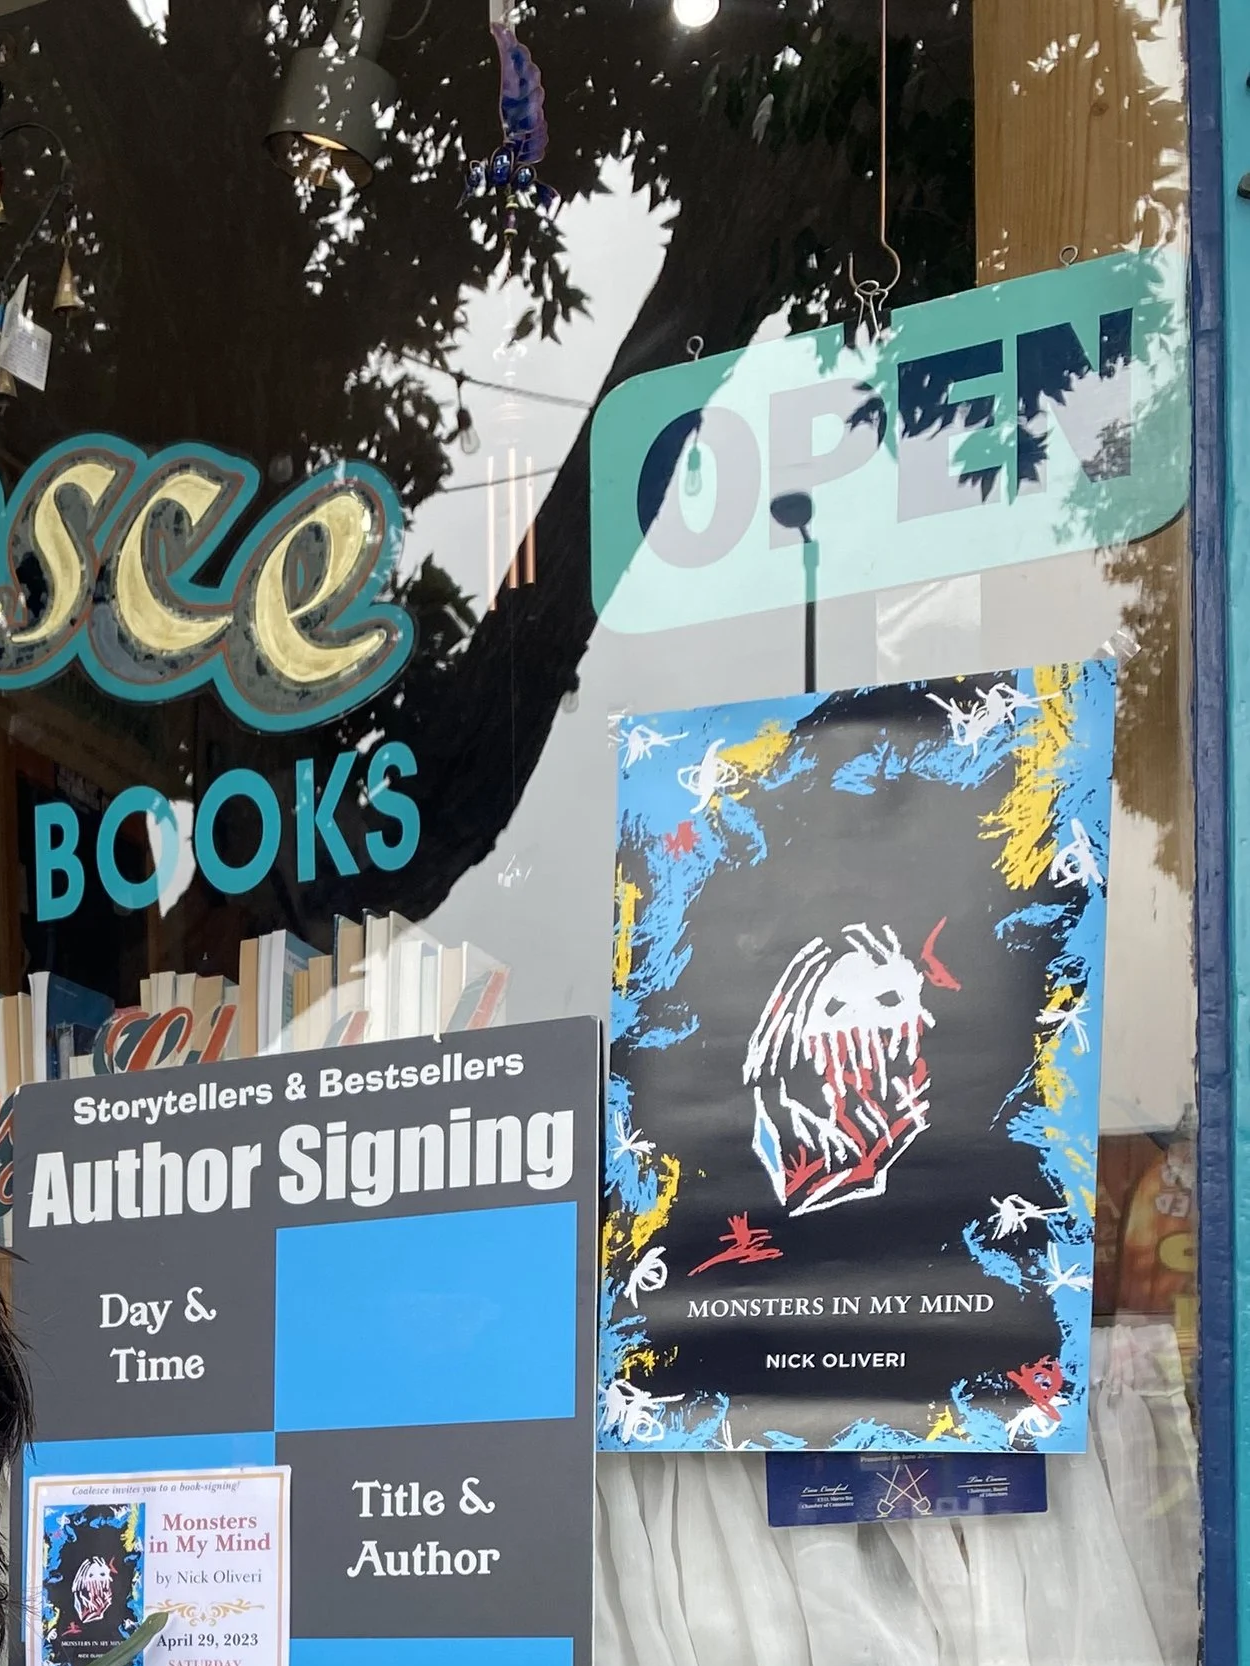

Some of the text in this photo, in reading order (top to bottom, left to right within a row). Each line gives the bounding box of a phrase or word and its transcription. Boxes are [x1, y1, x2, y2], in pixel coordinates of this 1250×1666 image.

[637, 308, 1133, 568] OPEN
[34, 742, 420, 922] BOOKS
[73, 1050, 524, 1125] Storytellers & Bestsellers
[28, 1108, 575, 1228] Author Signing
[99, 1286, 217, 1334] Day &
[688, 1293, 995, 1319] MONSTERS IN MY MIND
[109, 1347, 205, 1383] Time
[766, 1352, 906, 1370] NICK OLIVERI
[72, 1485, 110, 1496] Coalesce
[112, 1484, 140, 1495] invites
[142, 1486, 157, 1497] you
[159, 1484, 168, 1493] to
[180, 1481, 241, 1495] book-signing!
[352, 1477, 496, 1518] Title &
[162, 1512, 258, 1532] Monsters
[149, 1532, 271, 1558] in My Mind
[347, 1541, 500, 1578] Author
[156, 1568, 263, 1588] by Nick Oliveri
[156, 1633, 258, 1651] April 29, 2023
